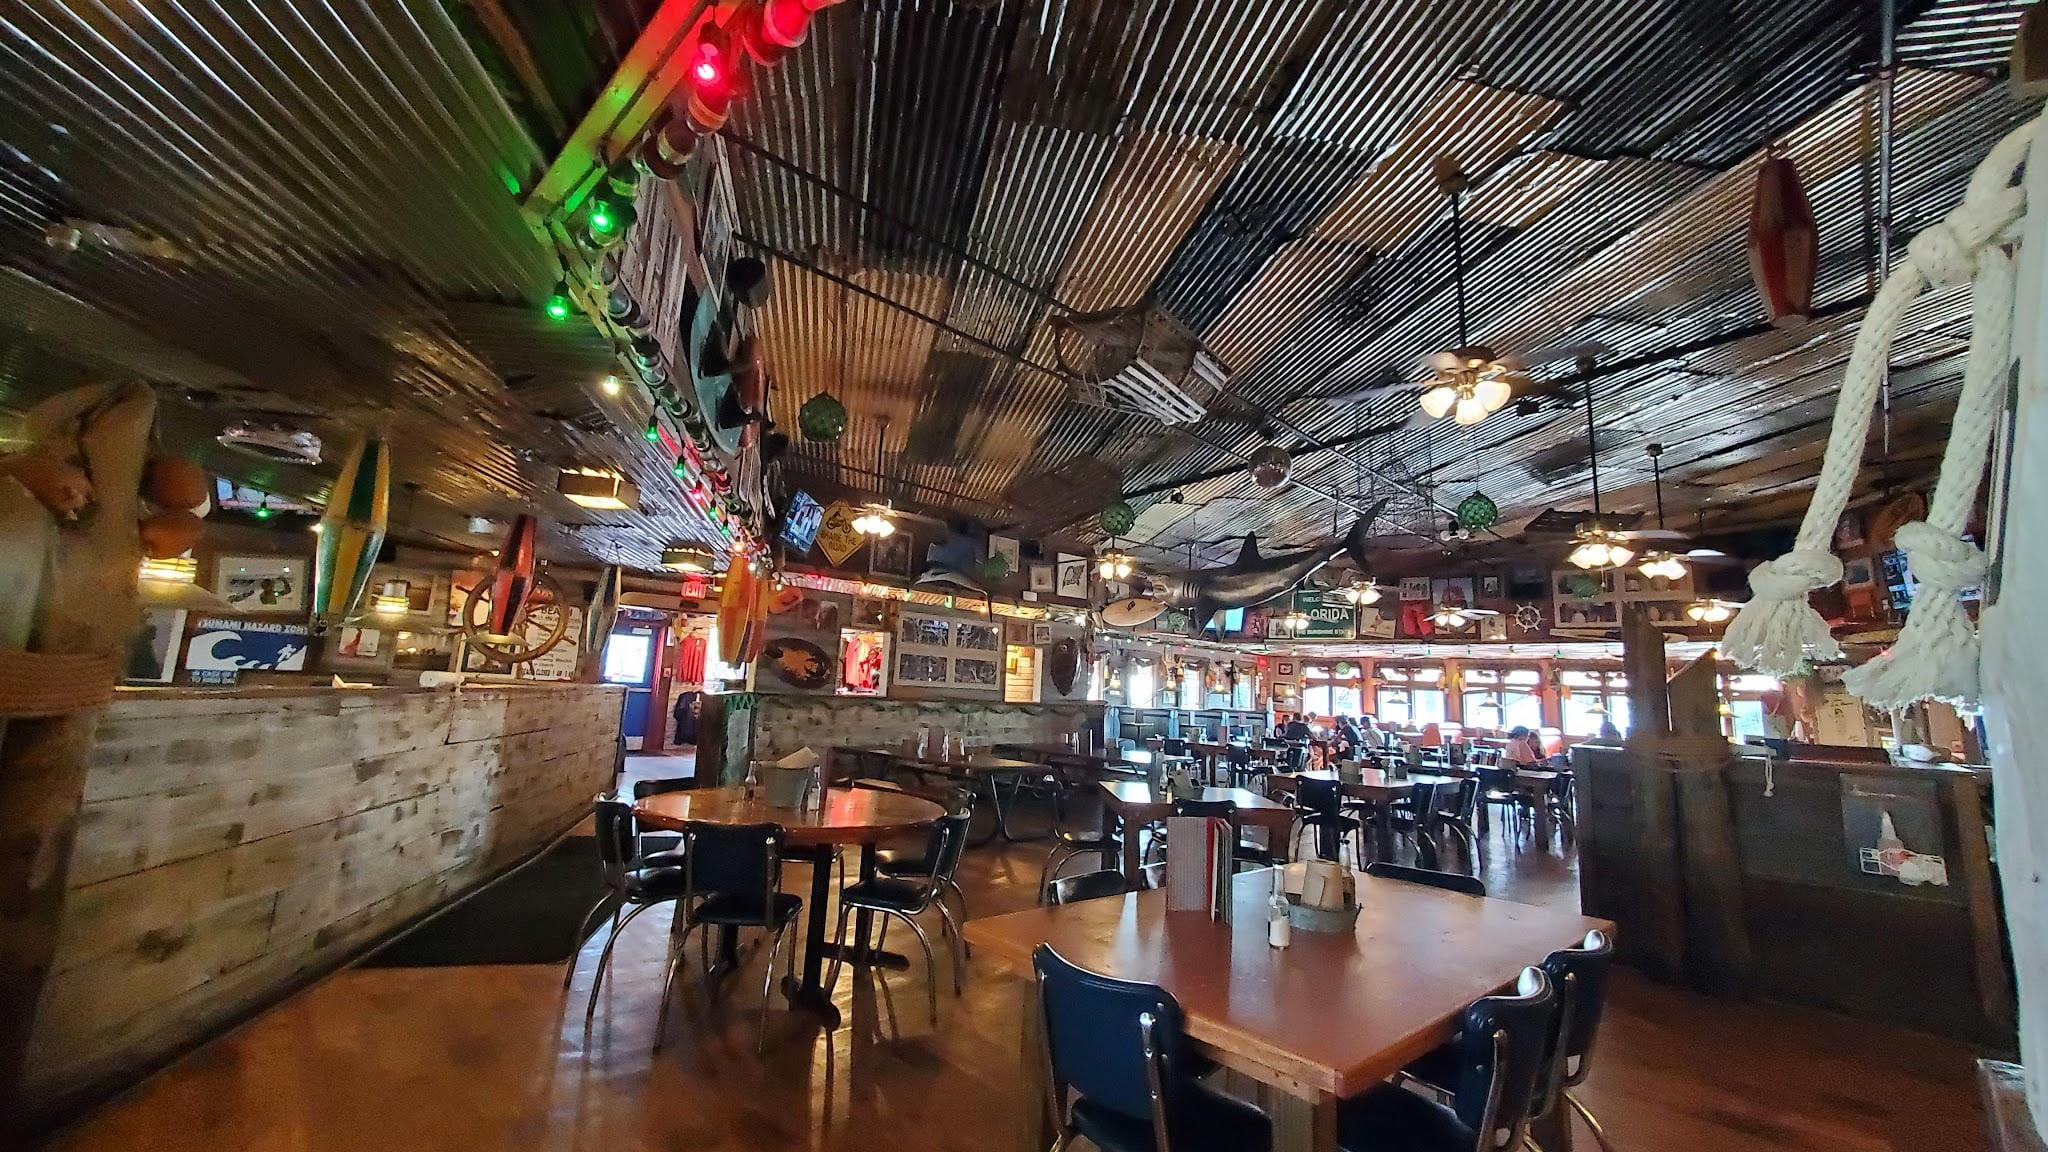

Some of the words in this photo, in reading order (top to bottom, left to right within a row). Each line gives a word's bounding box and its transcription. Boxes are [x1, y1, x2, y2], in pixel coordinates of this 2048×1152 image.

[685, 582, 704, 597] EXIT
[1310, 608, 1350, 621] ORIDA
[244, 621, 282, 633] HAZARD
